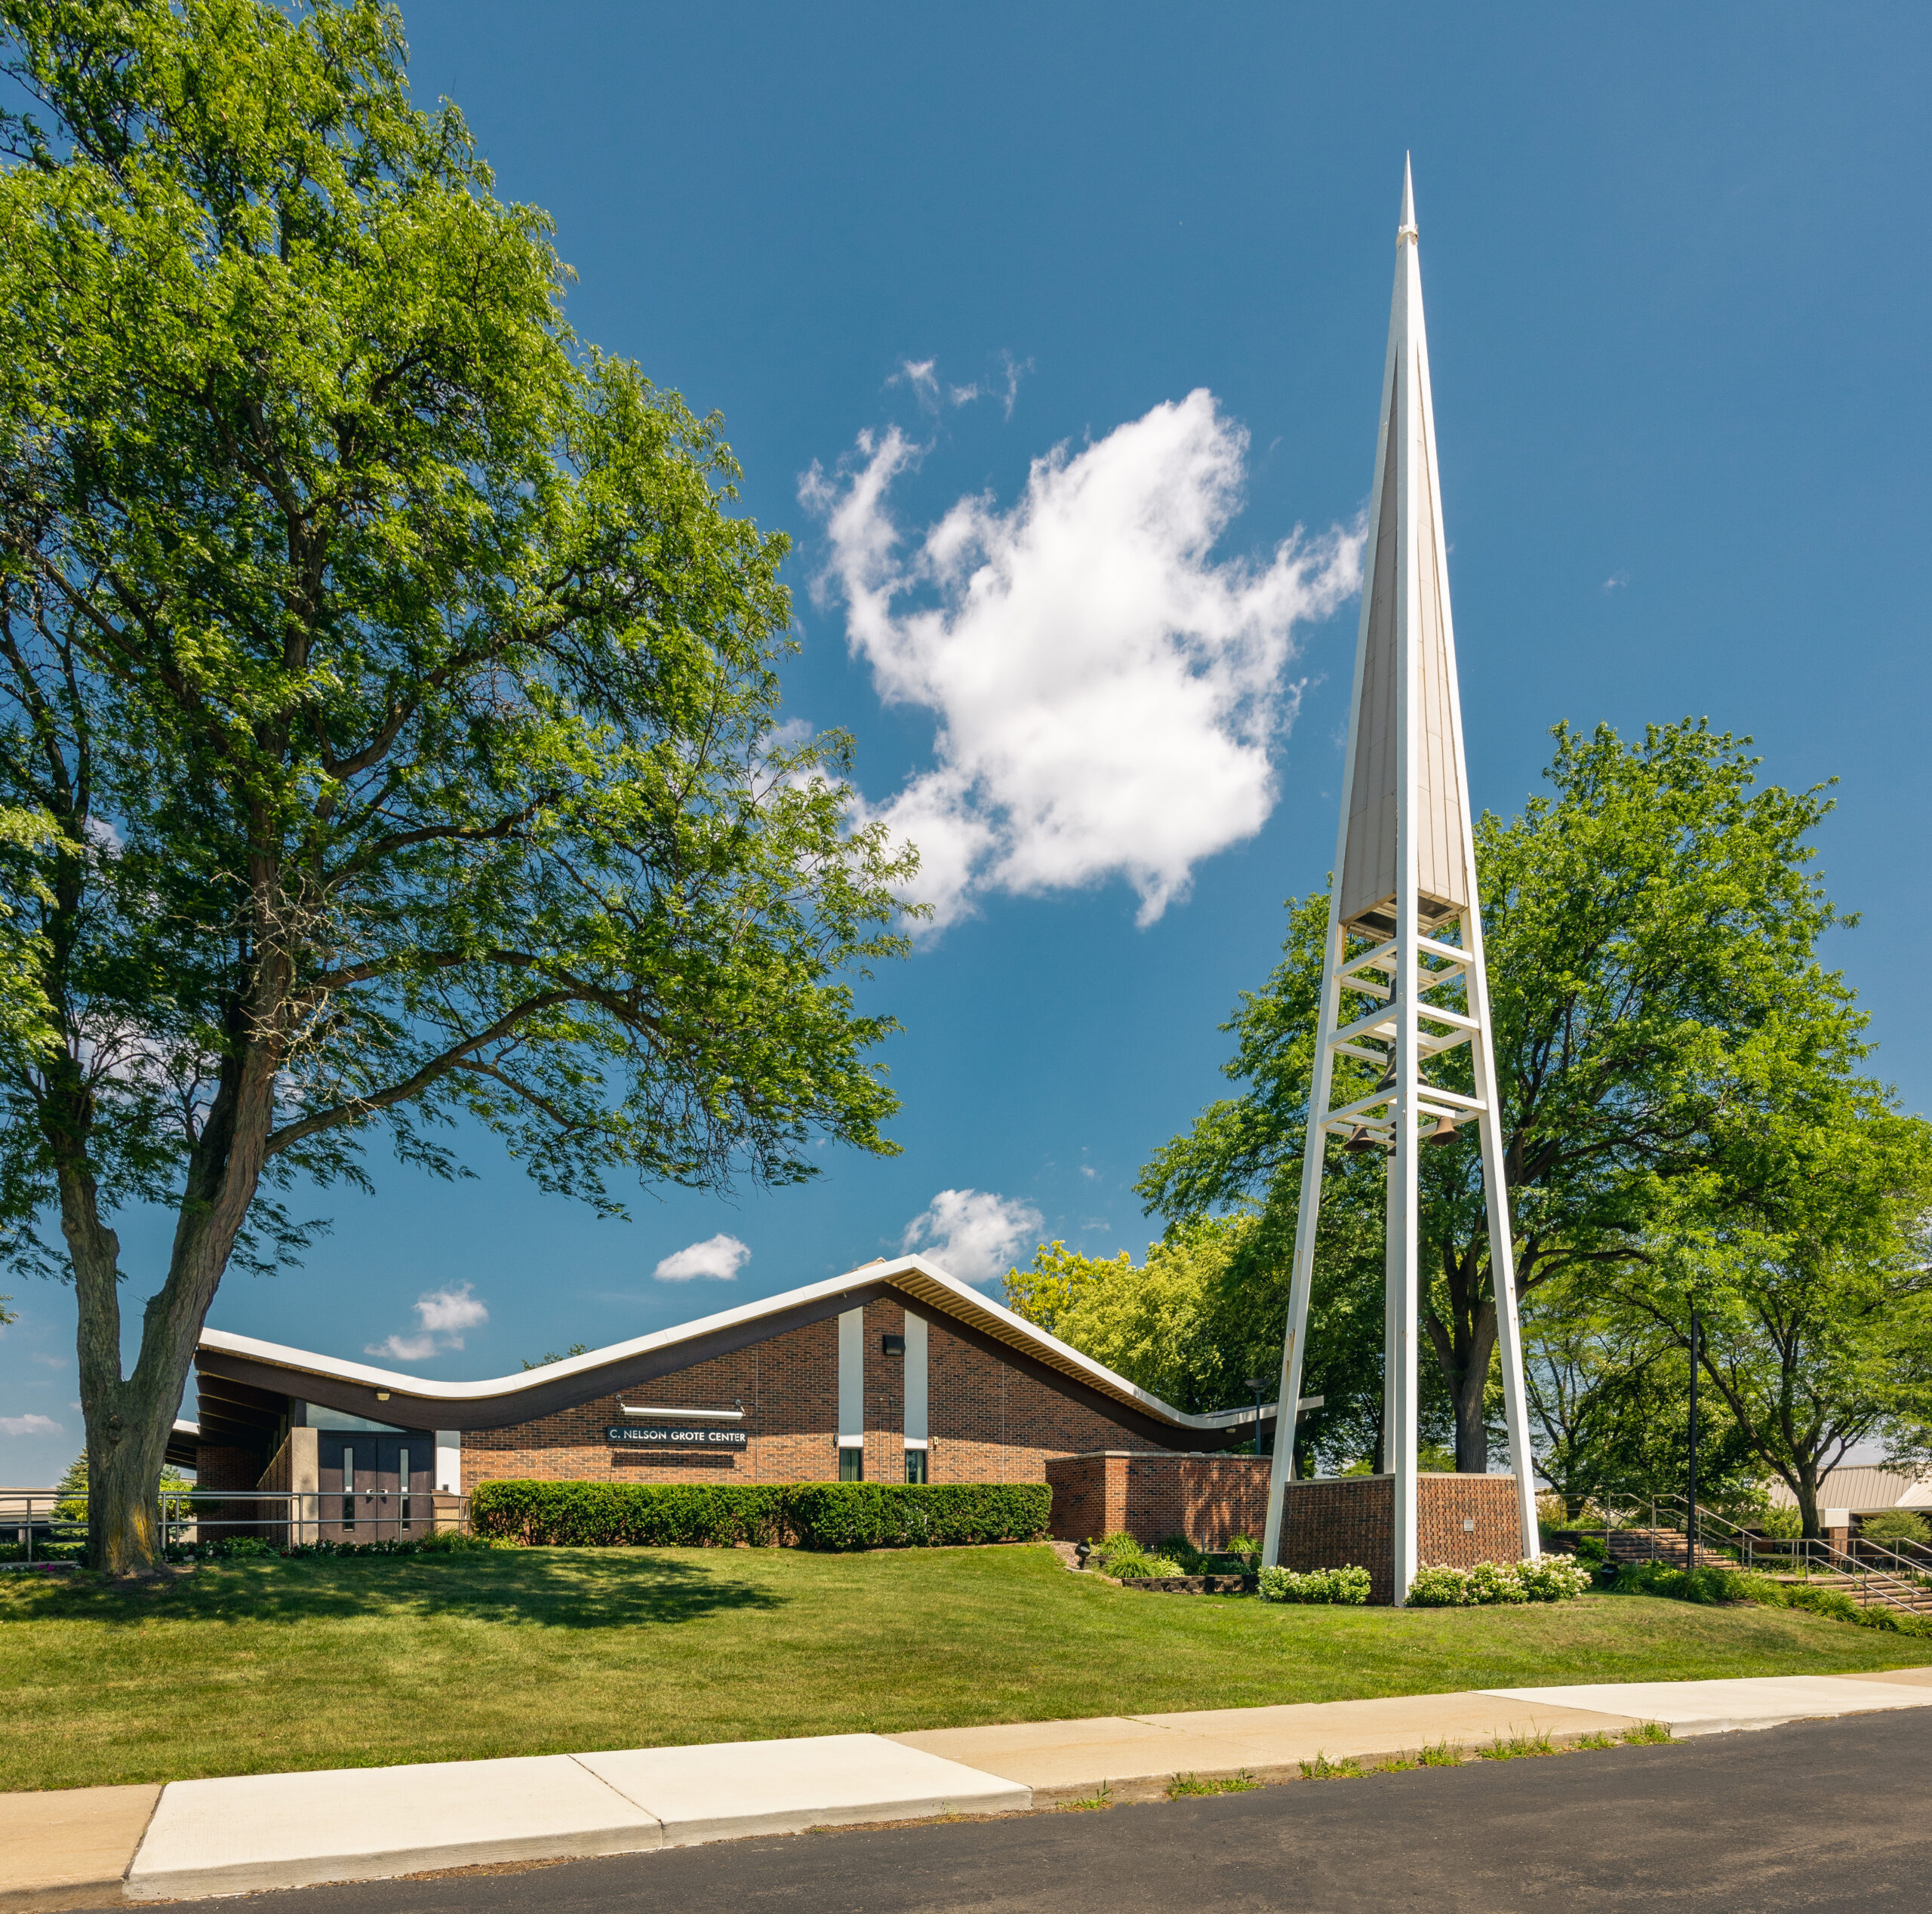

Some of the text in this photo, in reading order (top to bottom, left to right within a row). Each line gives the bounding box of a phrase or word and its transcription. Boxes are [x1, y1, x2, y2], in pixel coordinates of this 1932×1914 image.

[609, 1429, 746, 1442] C. NELSON GROTE CENTER
